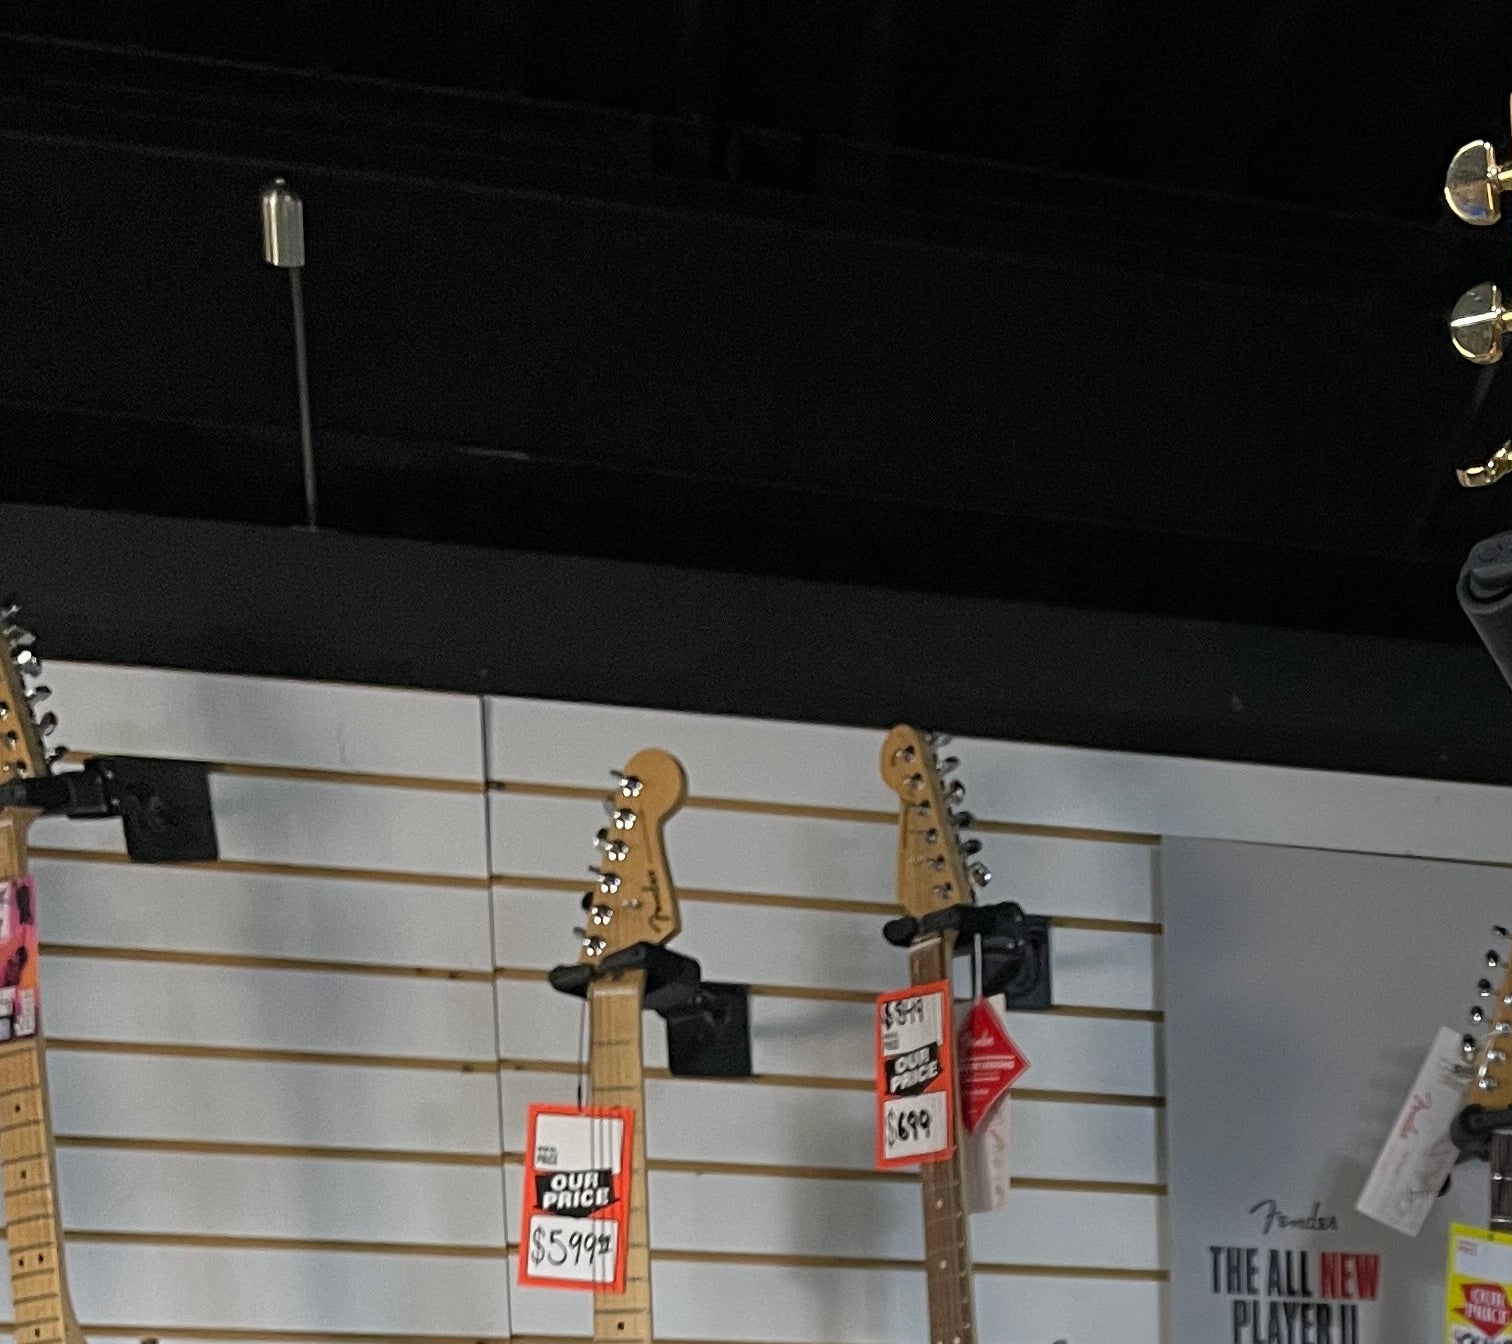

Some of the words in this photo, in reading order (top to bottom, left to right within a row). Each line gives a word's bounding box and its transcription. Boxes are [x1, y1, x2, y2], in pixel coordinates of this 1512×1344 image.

[894, 1047, 930, 1074] OUR
[889, 1061, 938, 1093] PRICE
[551, 1171, 599, 1191] OUR
[542, 1187, 610, 1209] PRICE
[1250, 1199, 1338, 1235] Fender
[1209, 1246, 1260, 1295] THE
[1267, 1249, 1312, 1298] ALL
[1319, 1251, 1380, 1301] NEW
[1470, 1287, 1506, 1306] OUR
